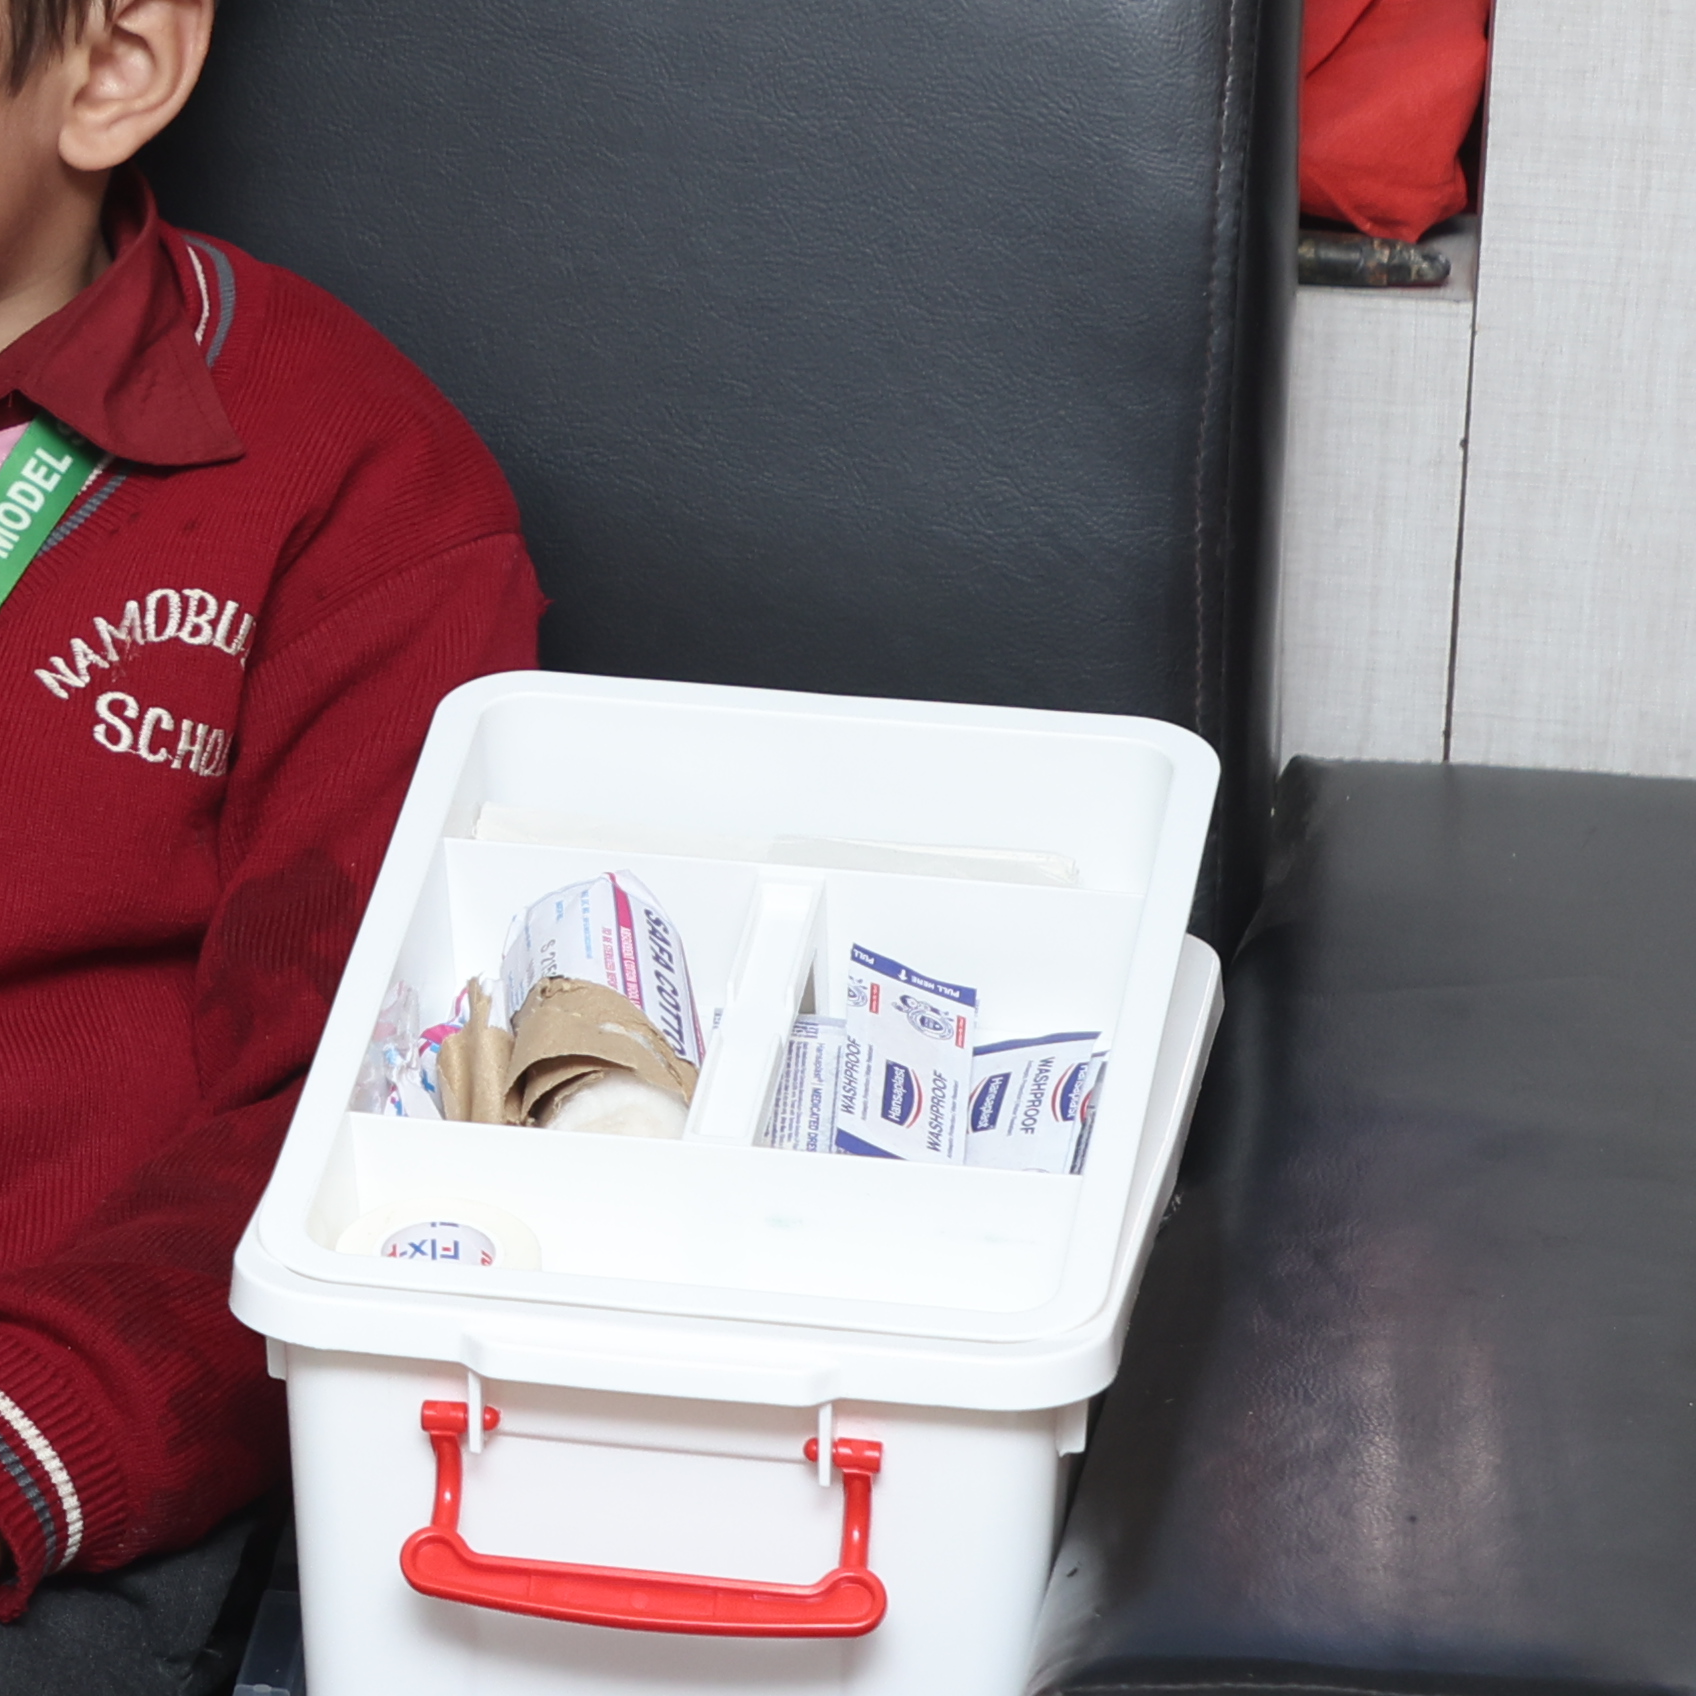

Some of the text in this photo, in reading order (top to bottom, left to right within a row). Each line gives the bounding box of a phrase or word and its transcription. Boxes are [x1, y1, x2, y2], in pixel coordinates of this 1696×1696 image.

[34, 588, 256, 700] NAMOBU
[93, 691, 233, 777] SCHO
[644, 908, 675, 974] SAFA
[853, 948, 874, 965] PULL
[911, 976, 961, 998] PULL HERE
[841, 1035, 863, 1115] WASHPROOF
[887, 1066, 906, 1121] Hansaplast
[976, 1076, 1004, 1130] Hansaplast
[1019, 1056, 1056, 1135] WASHPROOF
[809, 1088, 823, 1131] MEDICATED
[926, 1069, 949, 1152] WASHPROOF
